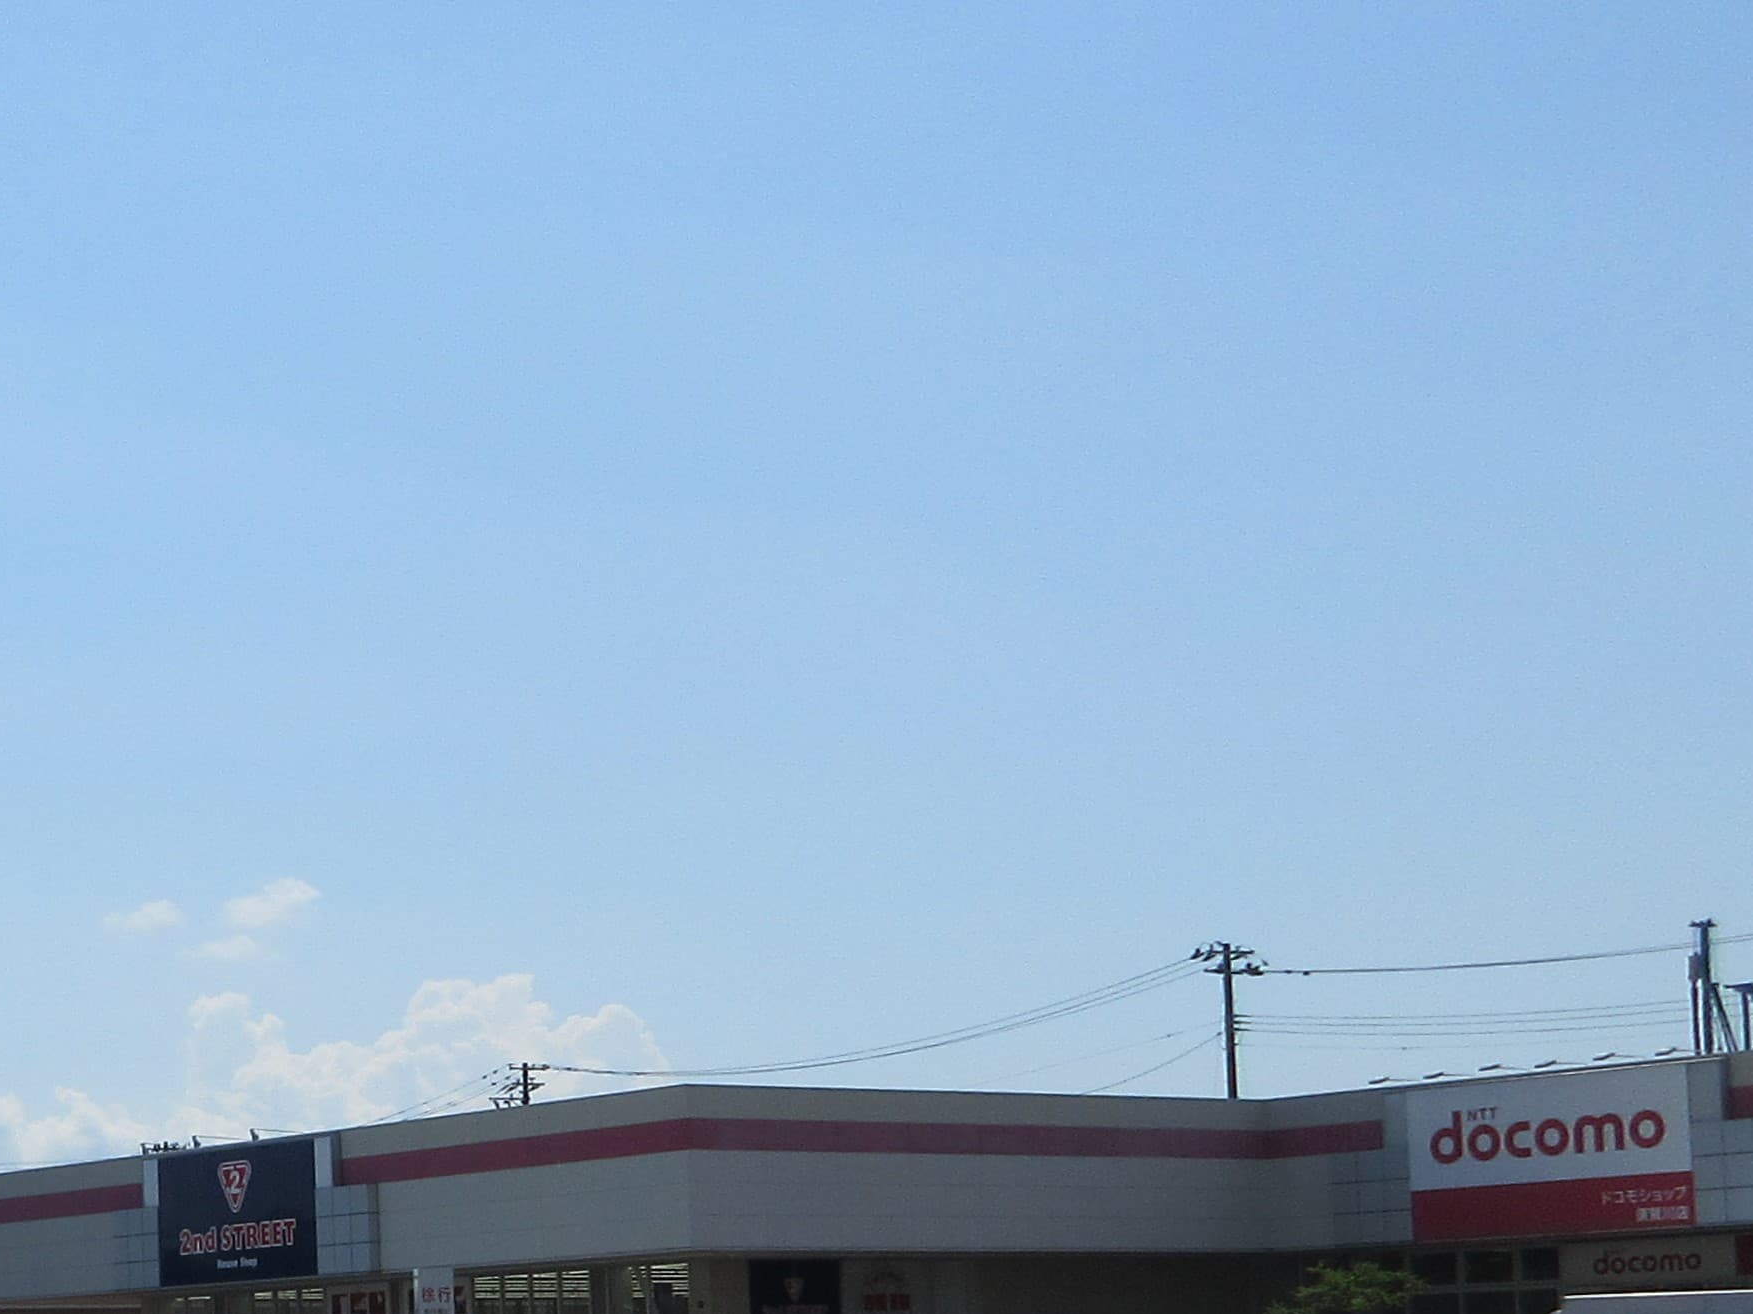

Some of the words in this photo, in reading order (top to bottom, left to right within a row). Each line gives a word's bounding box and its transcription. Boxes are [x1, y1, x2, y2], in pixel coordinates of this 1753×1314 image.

[1466, 1107, 1497, 1121] NTT
[1429, 1109, 1665, 1164] docomo
[1602, 1186, 1688, 1205] ドコモショップ
[179, 1227, 217, 1256] 2nd
[220, 1218, 296, 1251] STREET
[1593, 1253, 1701, 1275] docomo
[421, 1286, 451, 1303] 徐行
